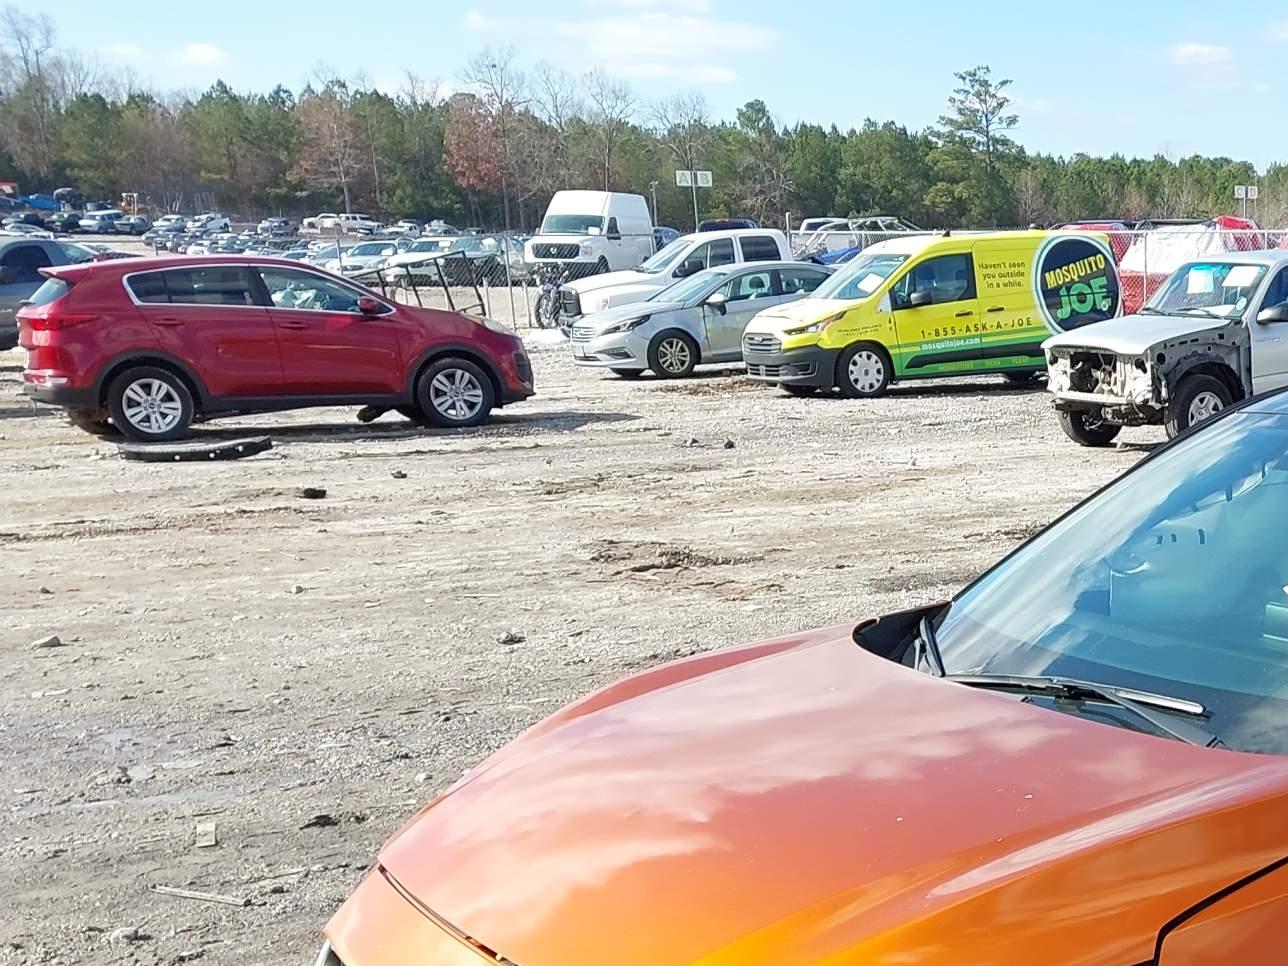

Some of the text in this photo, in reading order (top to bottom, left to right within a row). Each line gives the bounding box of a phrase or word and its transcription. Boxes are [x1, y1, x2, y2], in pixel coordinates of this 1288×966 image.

[678, 172, 690, 185] A
[978, 261, 1007, 270] Haven't
[1045, 254, 1106, 289] MOSQUITO
[982, 271, 1025, 281] you outside
[986, 281, 995, 289] in
[1056, 276, 1112, 320] JOE
[921, 317, 1033, 339] 1-855-ASK-A-JOE
[921, 337, 981, 351] mosquitojoe.com
